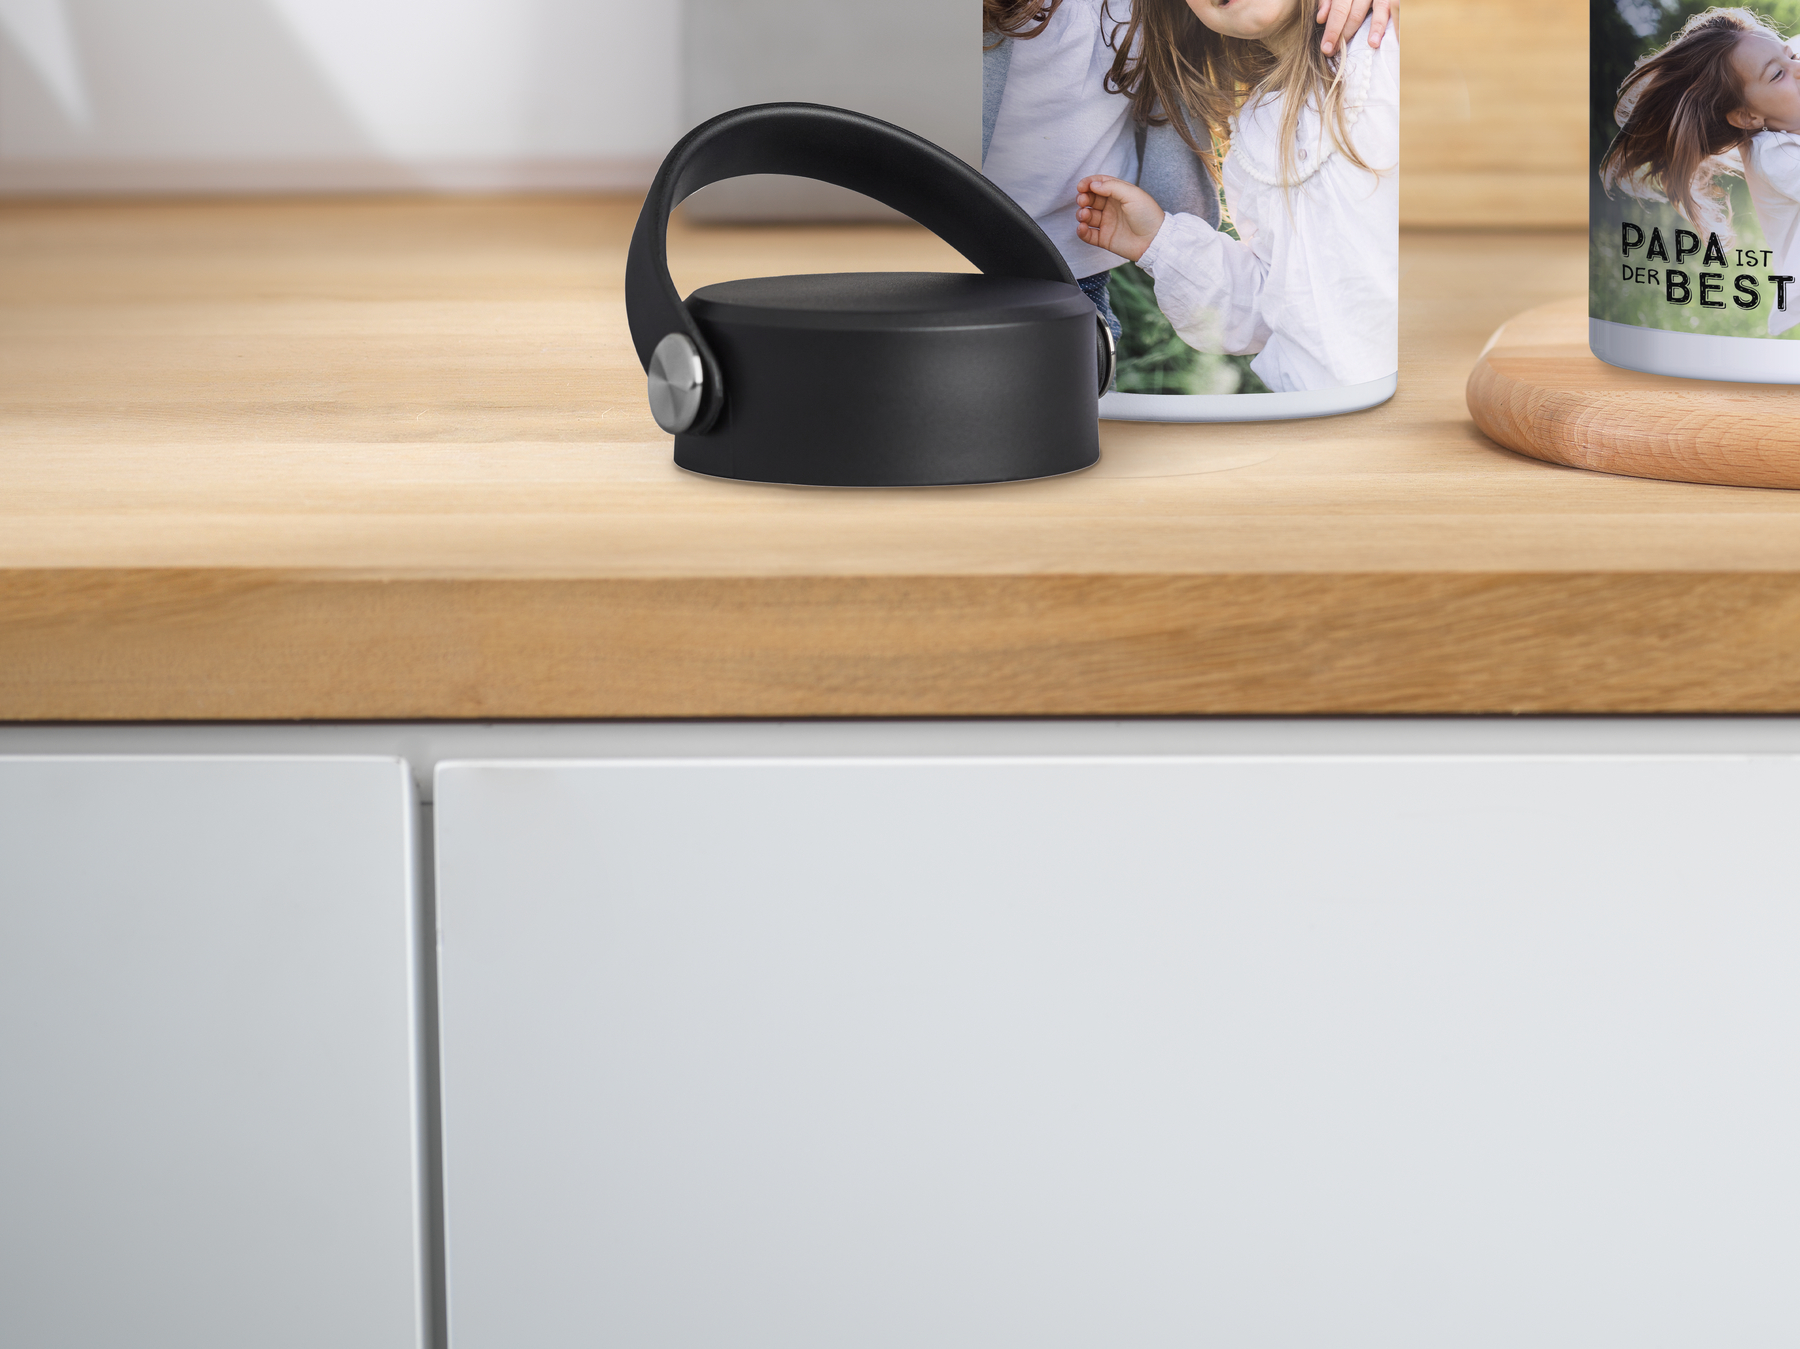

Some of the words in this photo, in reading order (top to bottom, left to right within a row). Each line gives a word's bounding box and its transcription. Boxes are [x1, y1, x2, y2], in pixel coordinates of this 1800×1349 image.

[1621, 221, 1729, 268] PAPA
[1735, 249, 1773, 268] IST
[1622, 263, 1660, 286] DER
